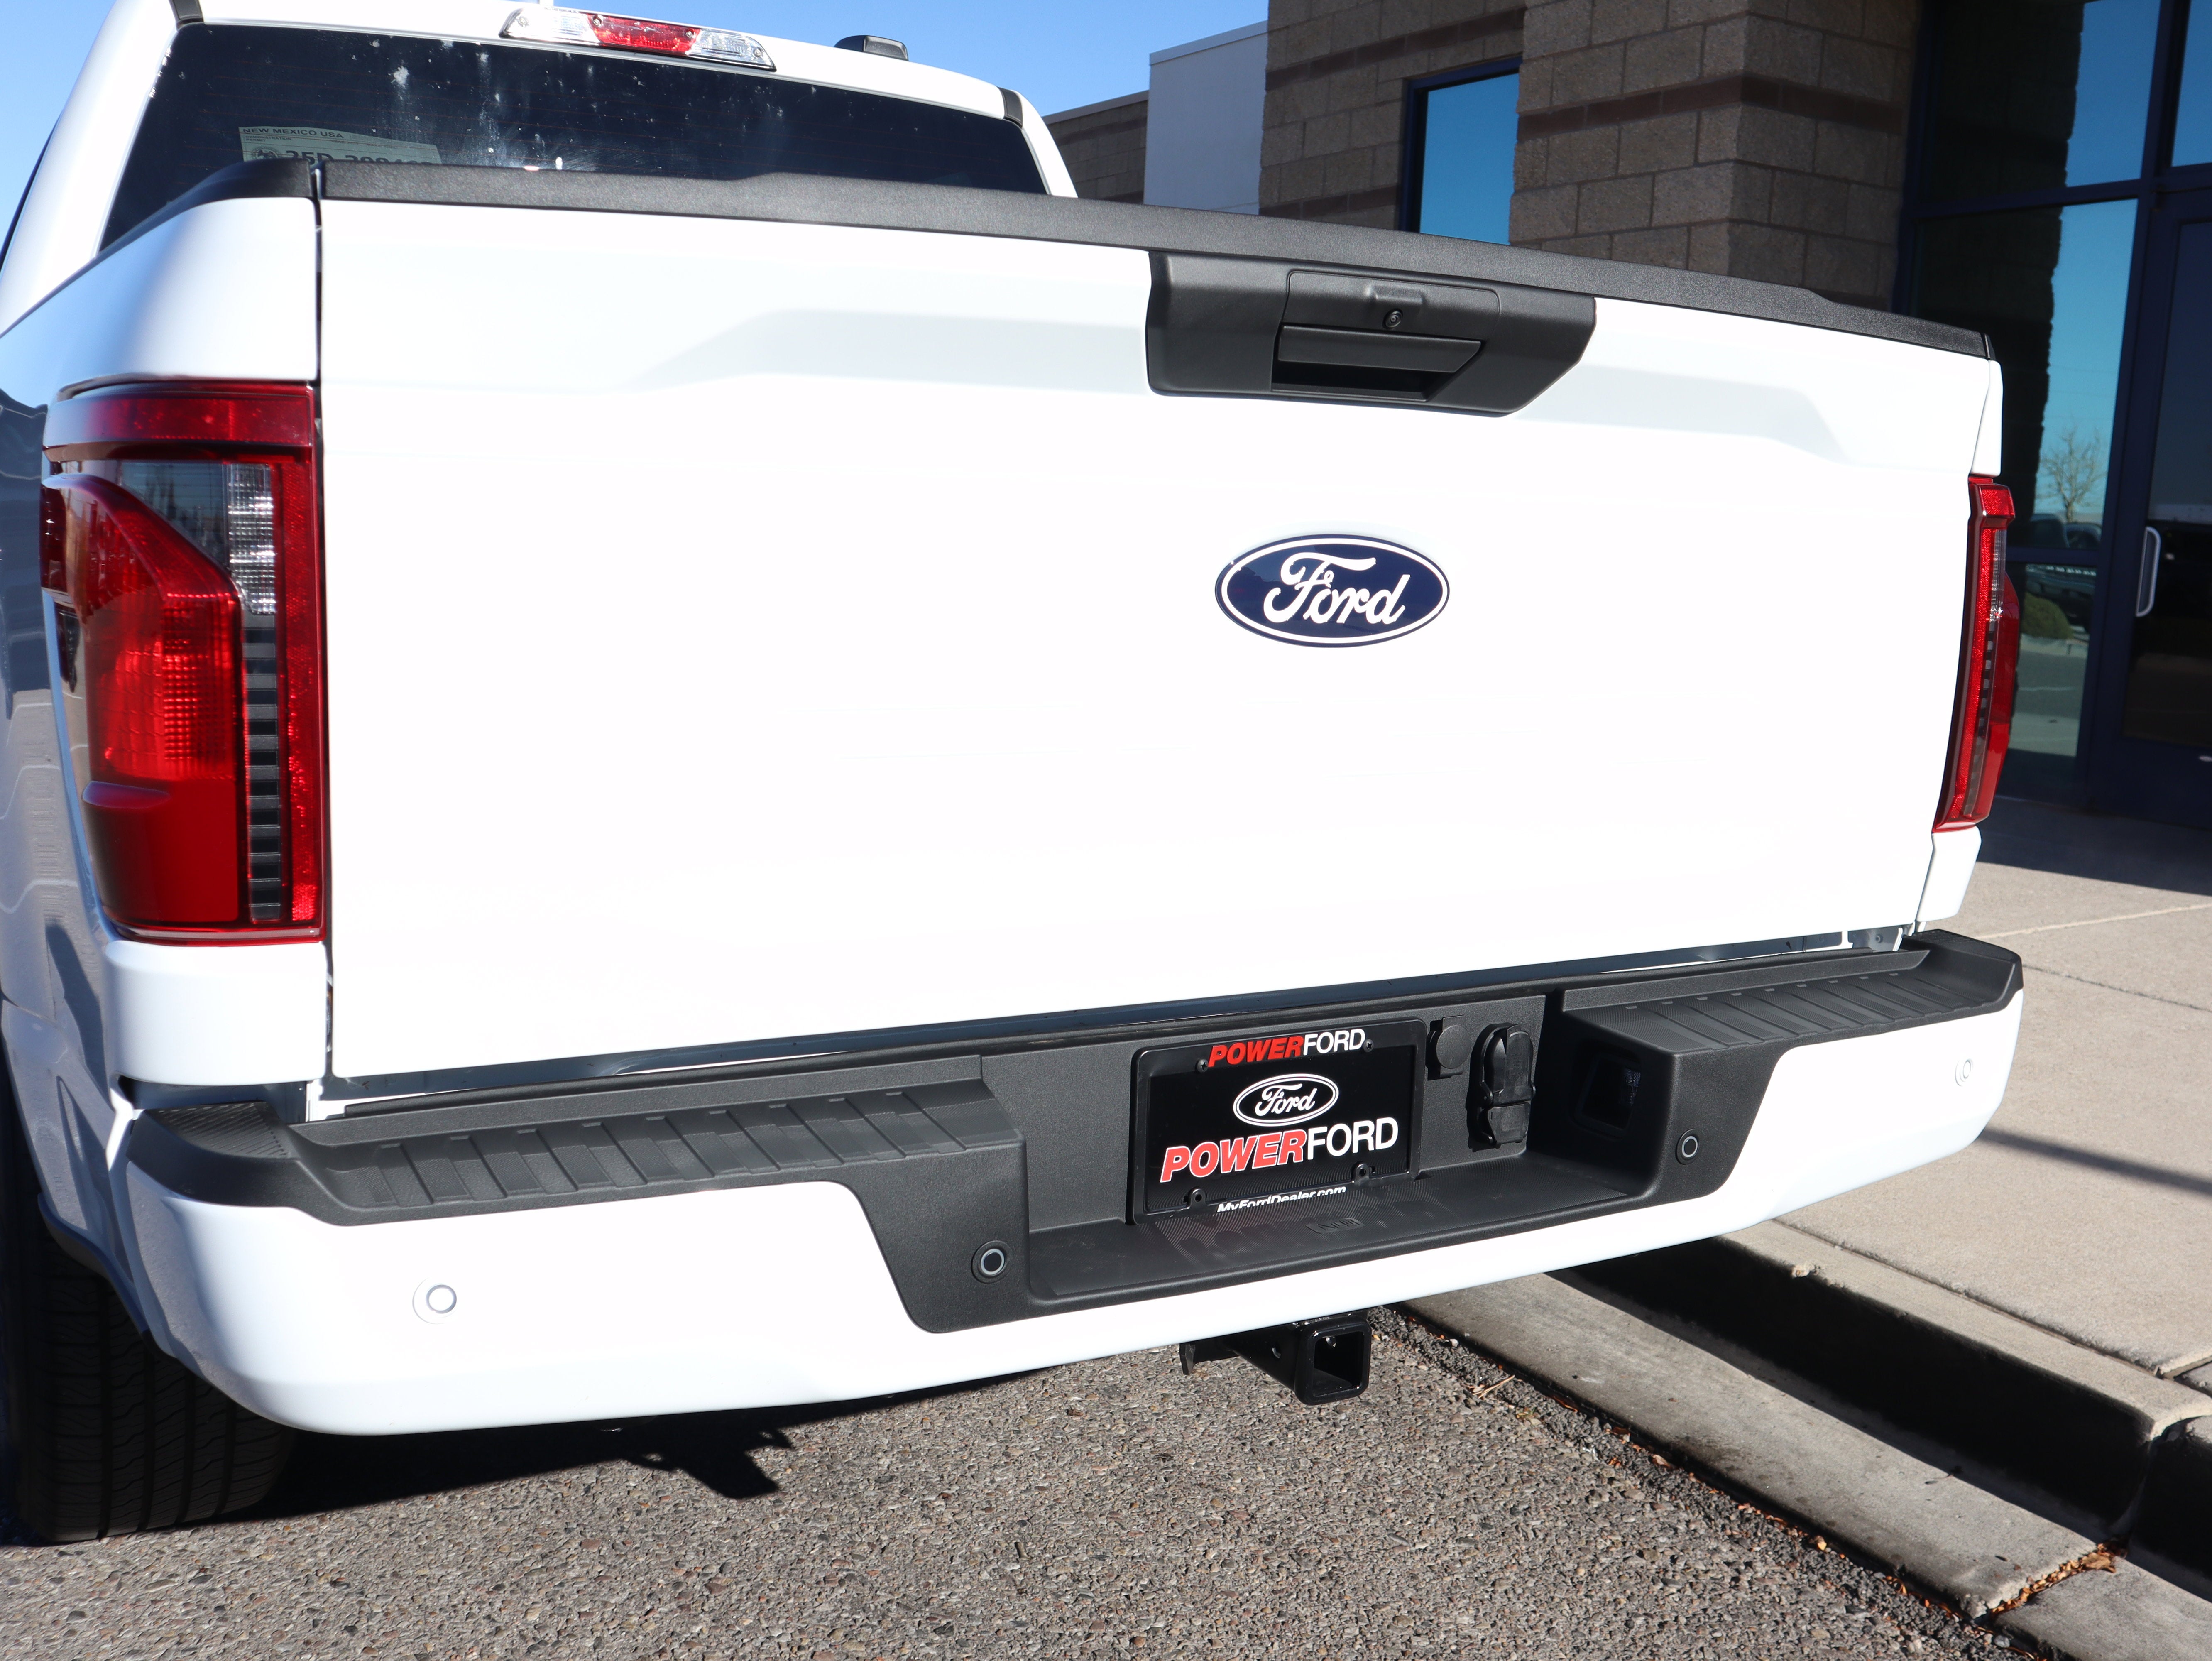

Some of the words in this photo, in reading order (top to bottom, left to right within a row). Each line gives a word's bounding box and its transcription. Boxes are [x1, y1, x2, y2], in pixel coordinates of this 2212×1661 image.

[1264, 553, 1411, 624] Ford
[1208, 1029, 1365, 1067] POWERFORD
[1255, 1083, 1317, 1117] Ford
[1160, 1117, 1399, 1183] POWERFORD
